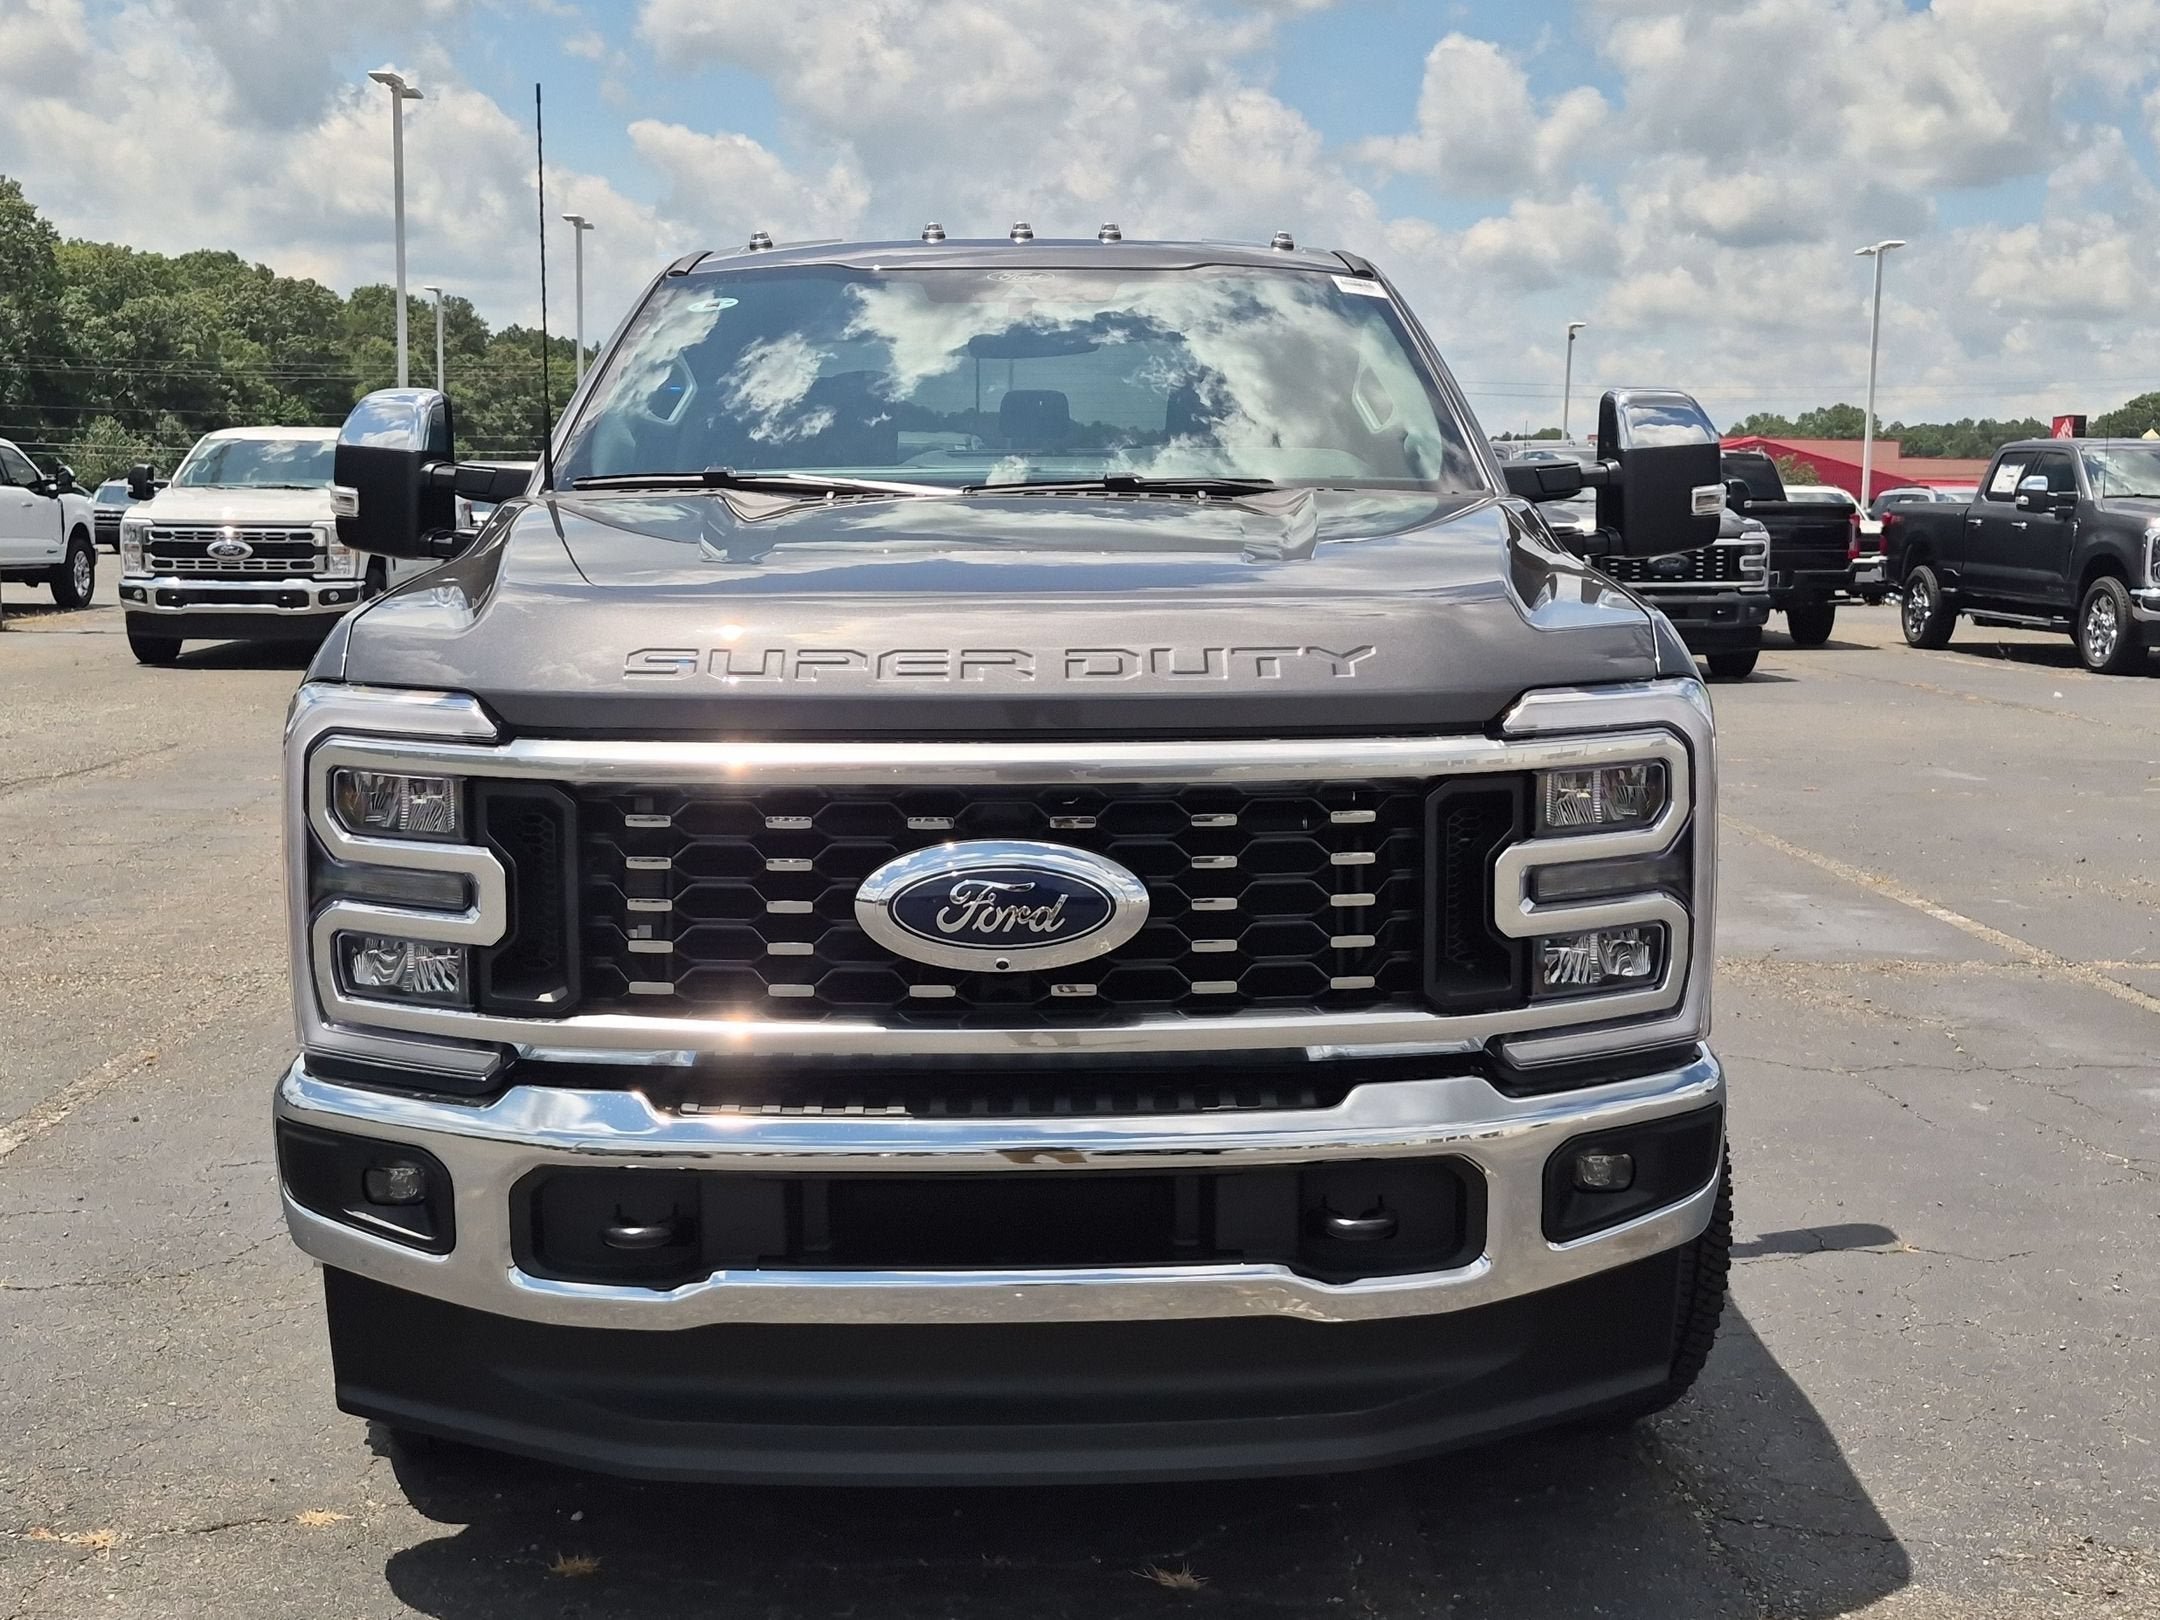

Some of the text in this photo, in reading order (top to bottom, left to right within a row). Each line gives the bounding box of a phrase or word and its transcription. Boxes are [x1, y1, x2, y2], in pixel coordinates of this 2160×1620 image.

[622, 644, 1377, 682] SUPER DUTY
[936, 879, 1069, 934] Ford
